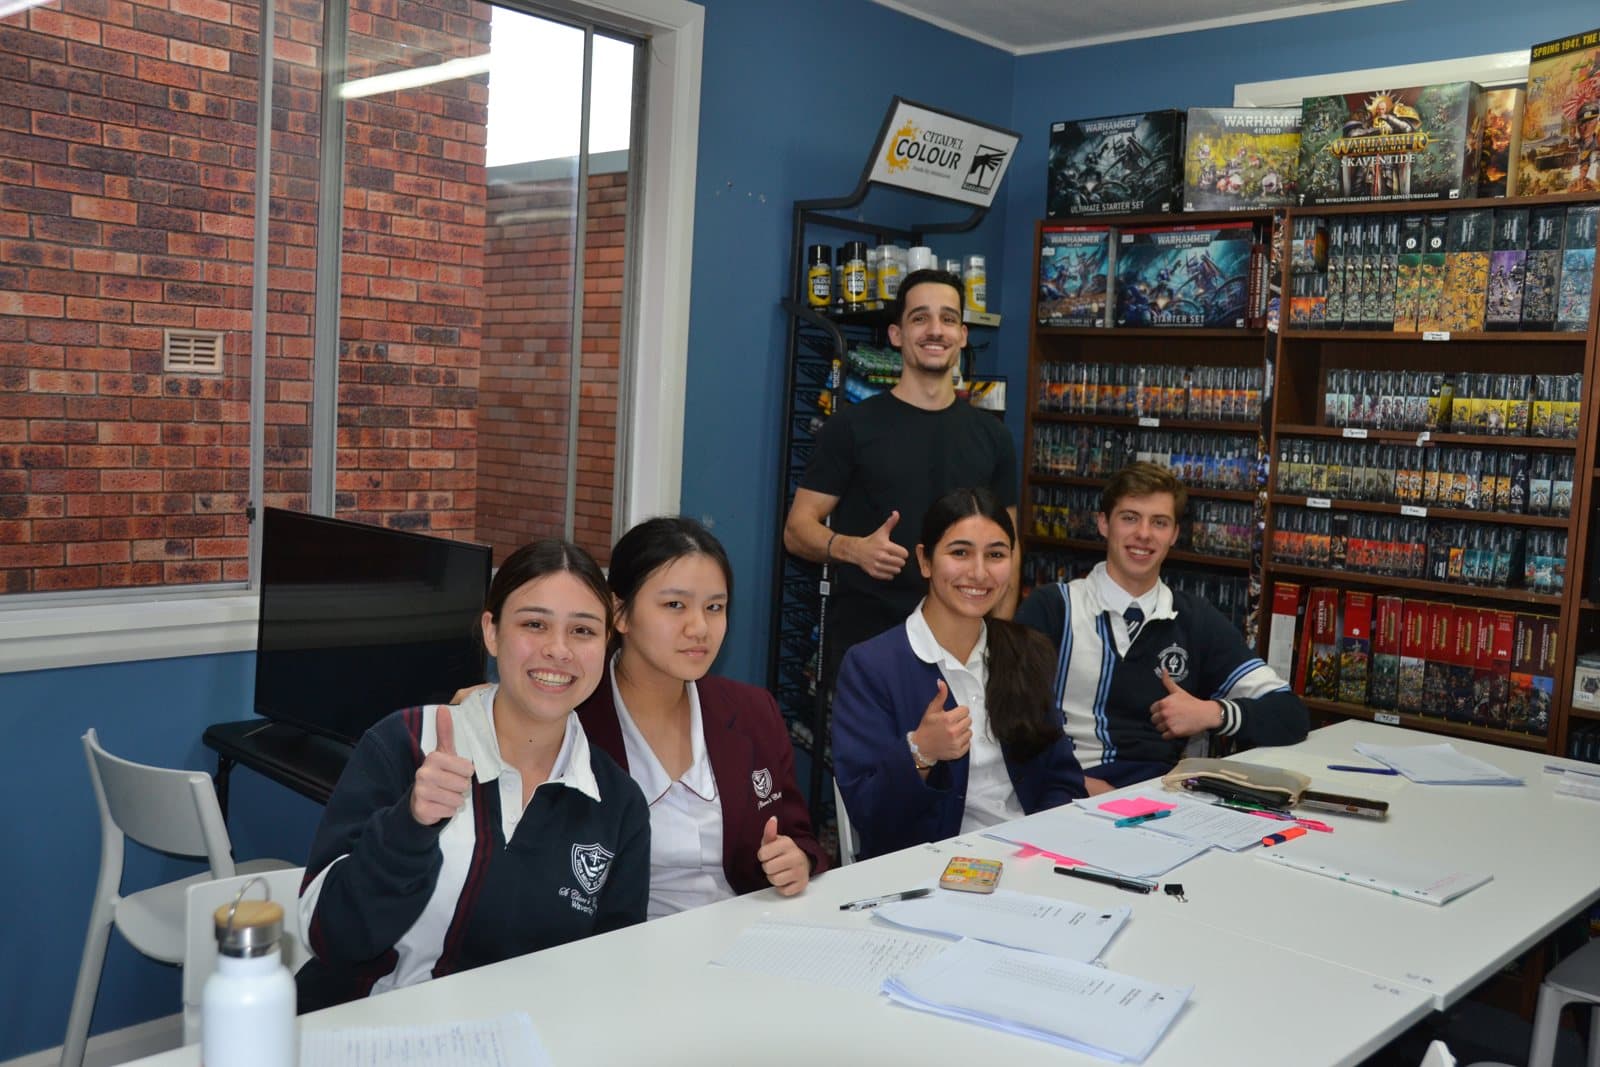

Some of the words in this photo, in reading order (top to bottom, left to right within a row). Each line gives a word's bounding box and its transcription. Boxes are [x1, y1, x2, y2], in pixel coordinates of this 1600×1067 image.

[1533, 43, 1560, 57] SPRING
[1583, 32, 1598, 45] THE
[1085, 119, 1136, 132] WARHAMMER
[1223, 115, 1302, 127] WARHAMME
[923, 130, 966, 151] CITADEL
[1331, 131, 1428, 156] WARHAMMER
[896, 138, 962, 170] COLOUR
[1341, 154, 1416, 167] SKAVENTIDE
[1071, 203, 1100, 214] ULTIMATE
[1102, 202, 1130, 212] STARTER
[1131, 200, 1144, 209] SET
[1051, 235, 1099, 244] WARHAMMER
[1157, 233, 1210, 245] WARHAMMER
[1152, 315, 1186, 324] STARTER
[1189, 315, 1205, 323] SET
